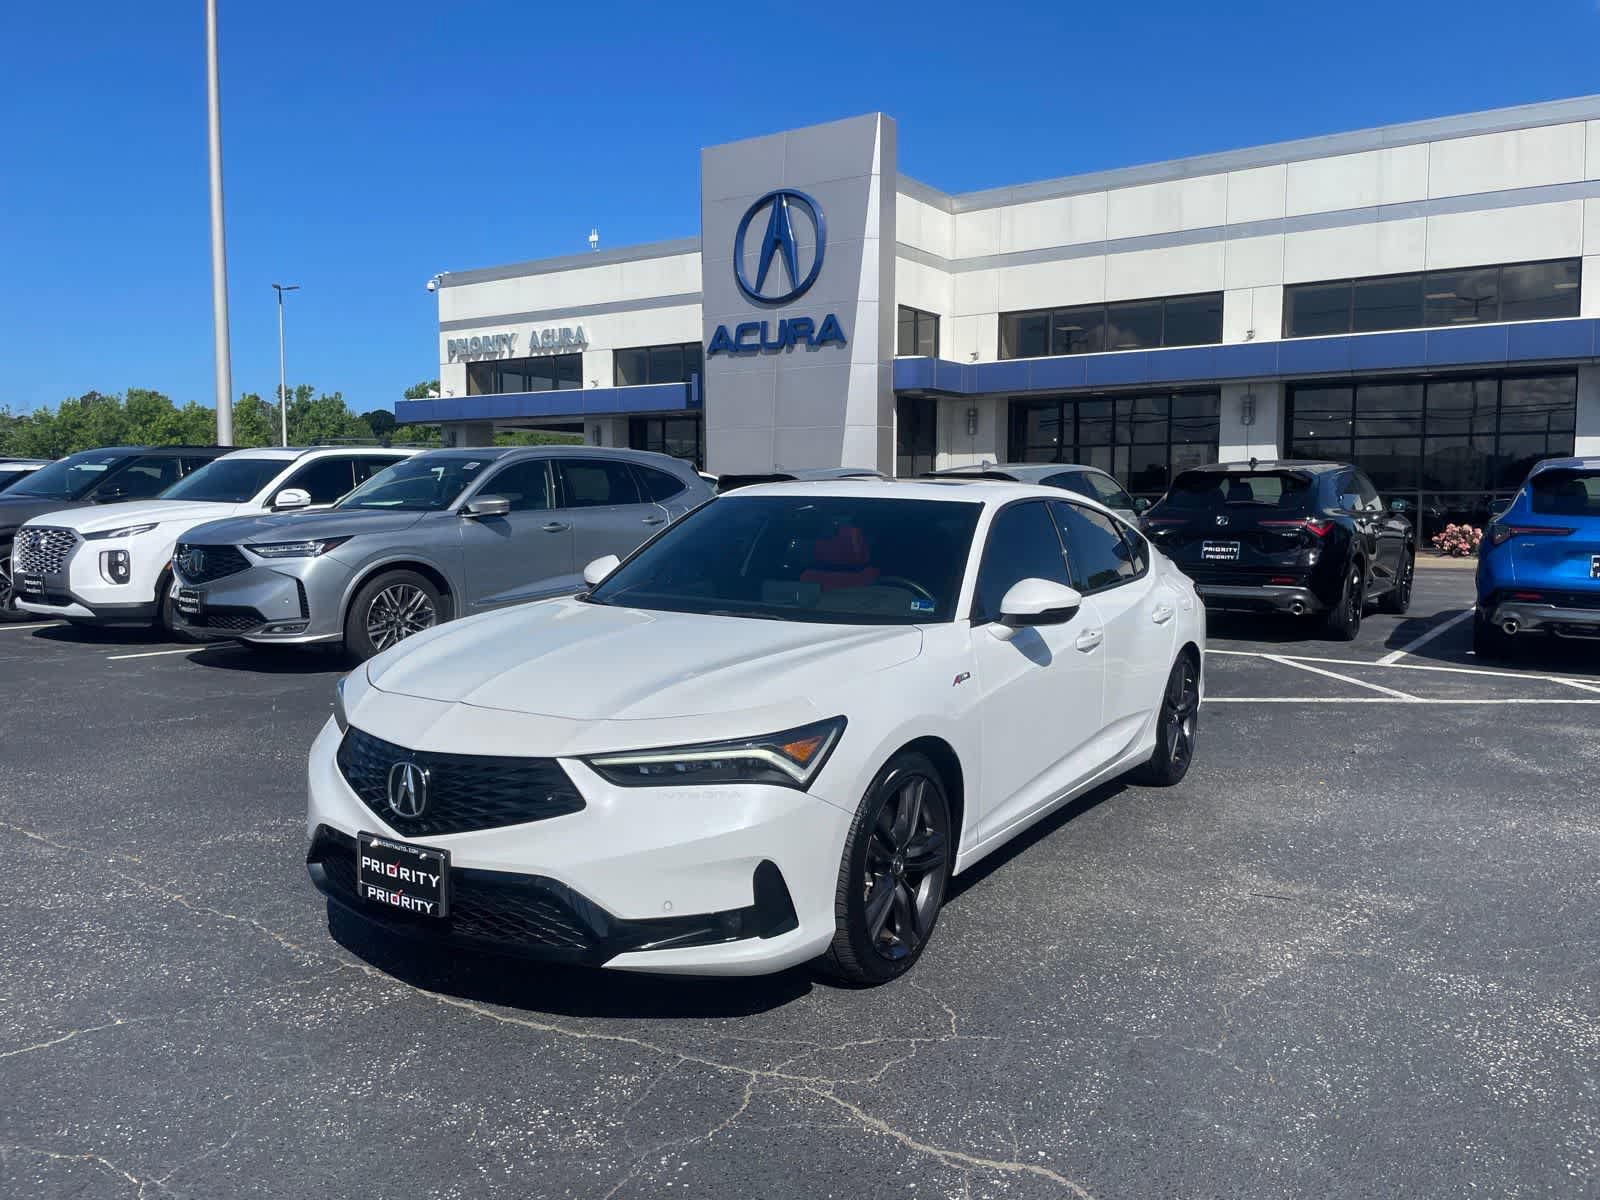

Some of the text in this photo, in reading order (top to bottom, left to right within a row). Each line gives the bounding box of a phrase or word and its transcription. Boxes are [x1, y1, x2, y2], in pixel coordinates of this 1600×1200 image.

[447, 325, 587, 357] PRIORITY ACURA
[706, 313, 847, 353] ACURA
[361, 856, 440, 888] PRIORITY
[367, 886, 434, 914] PRIORITY
